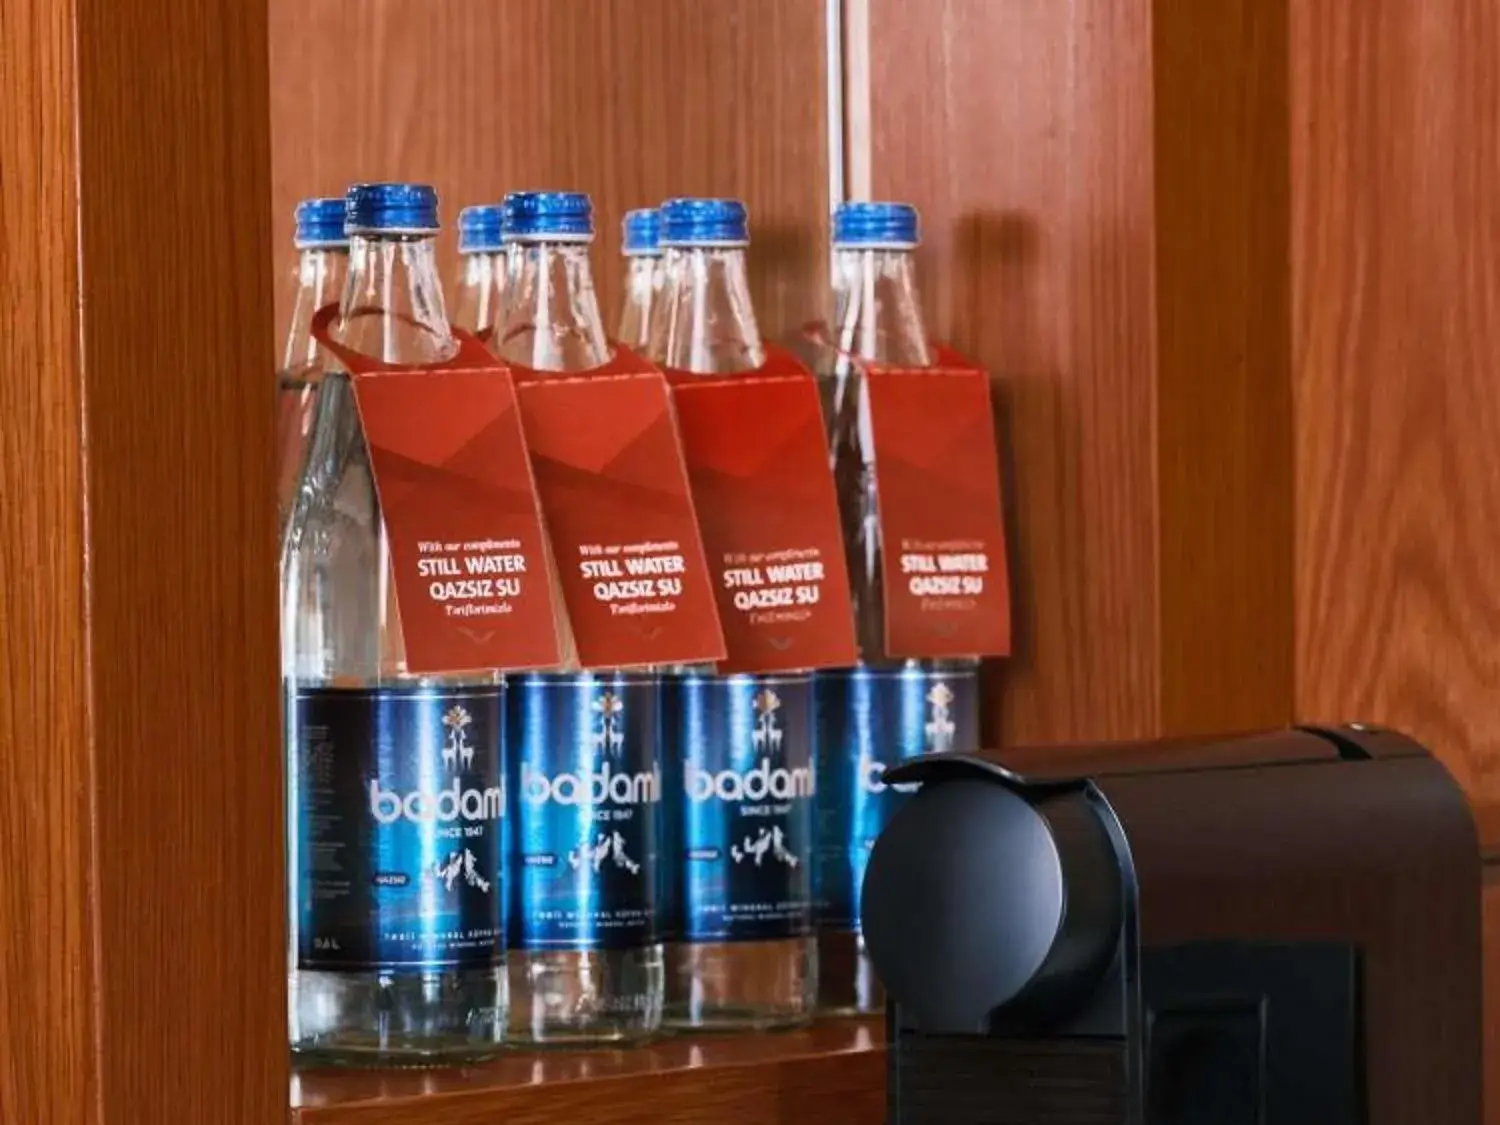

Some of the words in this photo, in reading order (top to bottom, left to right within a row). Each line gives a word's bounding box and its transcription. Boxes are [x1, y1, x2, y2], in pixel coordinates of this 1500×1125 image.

[418, 557, 462, 577] STILL
[463, 554, 527, 575] WATER
[579, 559, 623, 579] STILL
[624, 555, 685, 576] WATER
[723, 566, 764, 589] STILL
[765, 560, 824, 583] WATER
[900, 553, 937, 573] STILL
[937, 552, 989, 573] WATER
[429, 579, 494, 602] QAZSIZ
[495, 577, 521, 598] SU
[593, 579, 656, 601] QAZSIZ
[657, 577, 683, 597] SU
[733, 586, 794, 610] QAZSIZ
[795, 584, 819, 605] SU
[962, 575, 984, 596] SU
